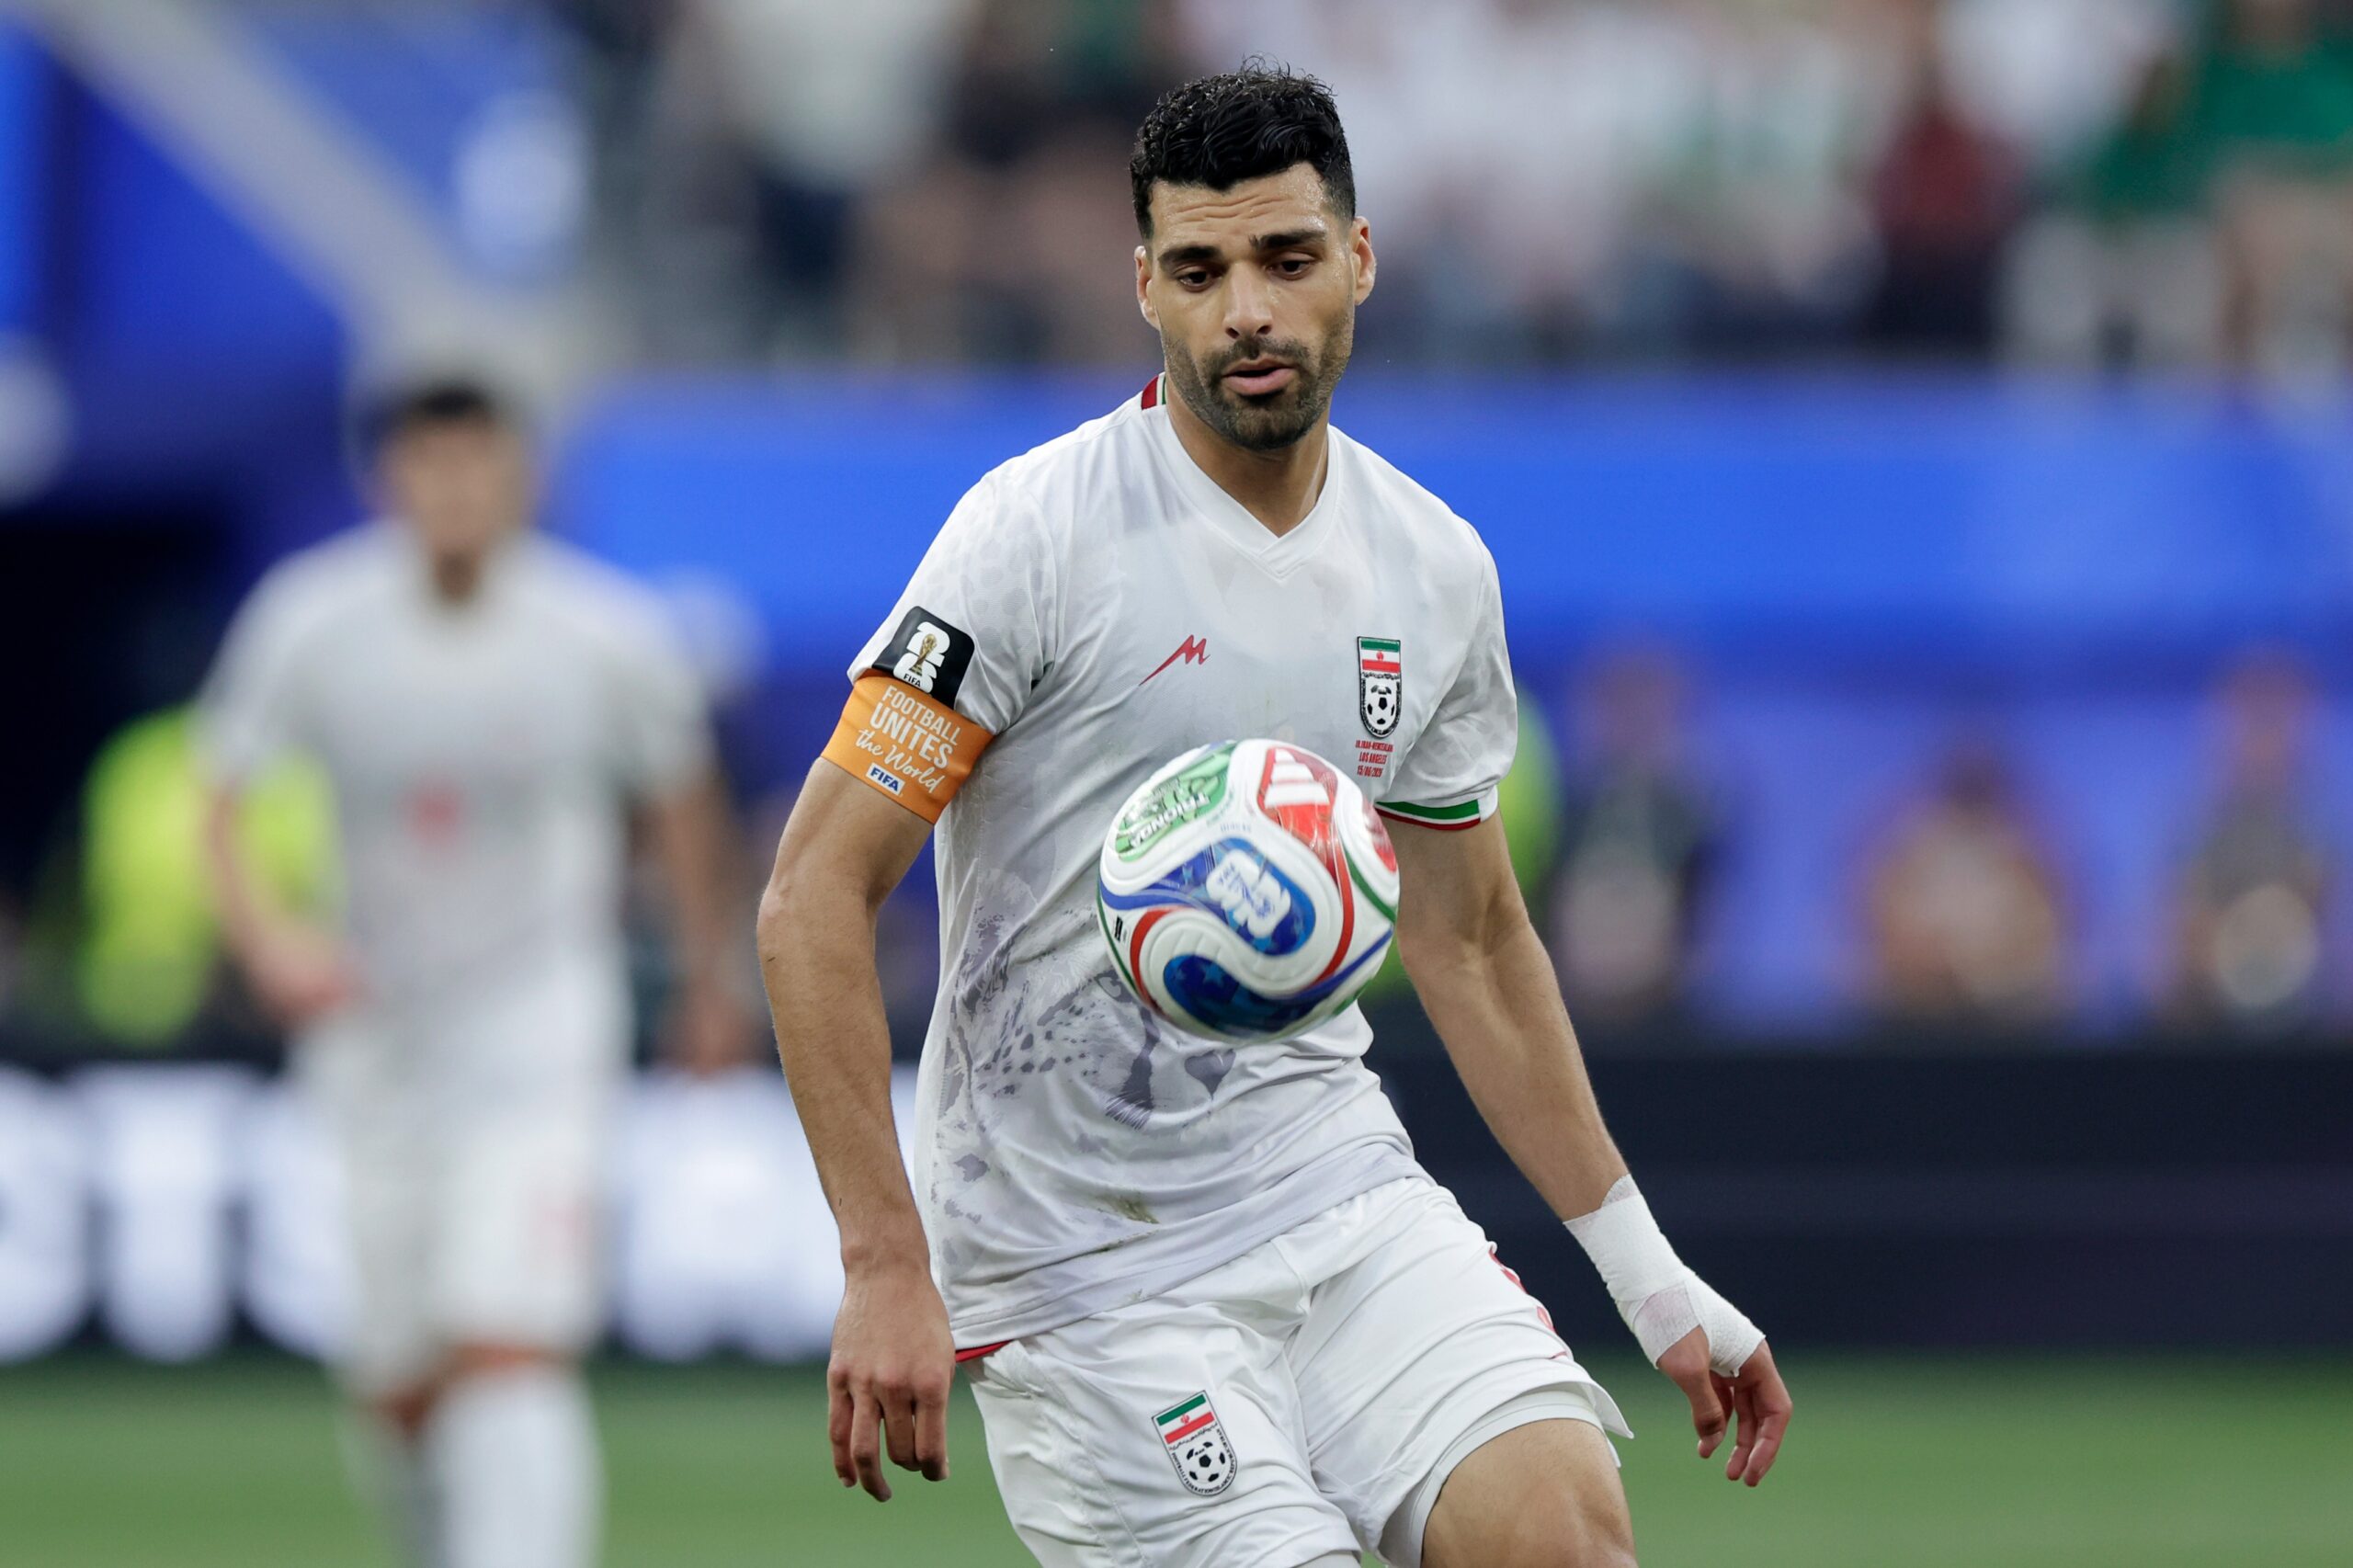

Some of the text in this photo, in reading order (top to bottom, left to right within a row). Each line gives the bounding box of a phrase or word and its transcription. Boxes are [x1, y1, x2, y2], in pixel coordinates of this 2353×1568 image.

[903, 674, 922, 687] FIFA
[870, 702, 953, 768] UNITES
[881, 685, 961, 745] FOOTBALL
[856, 729, 945, 793] the World
[870, 767, 899, 791] FIFA
